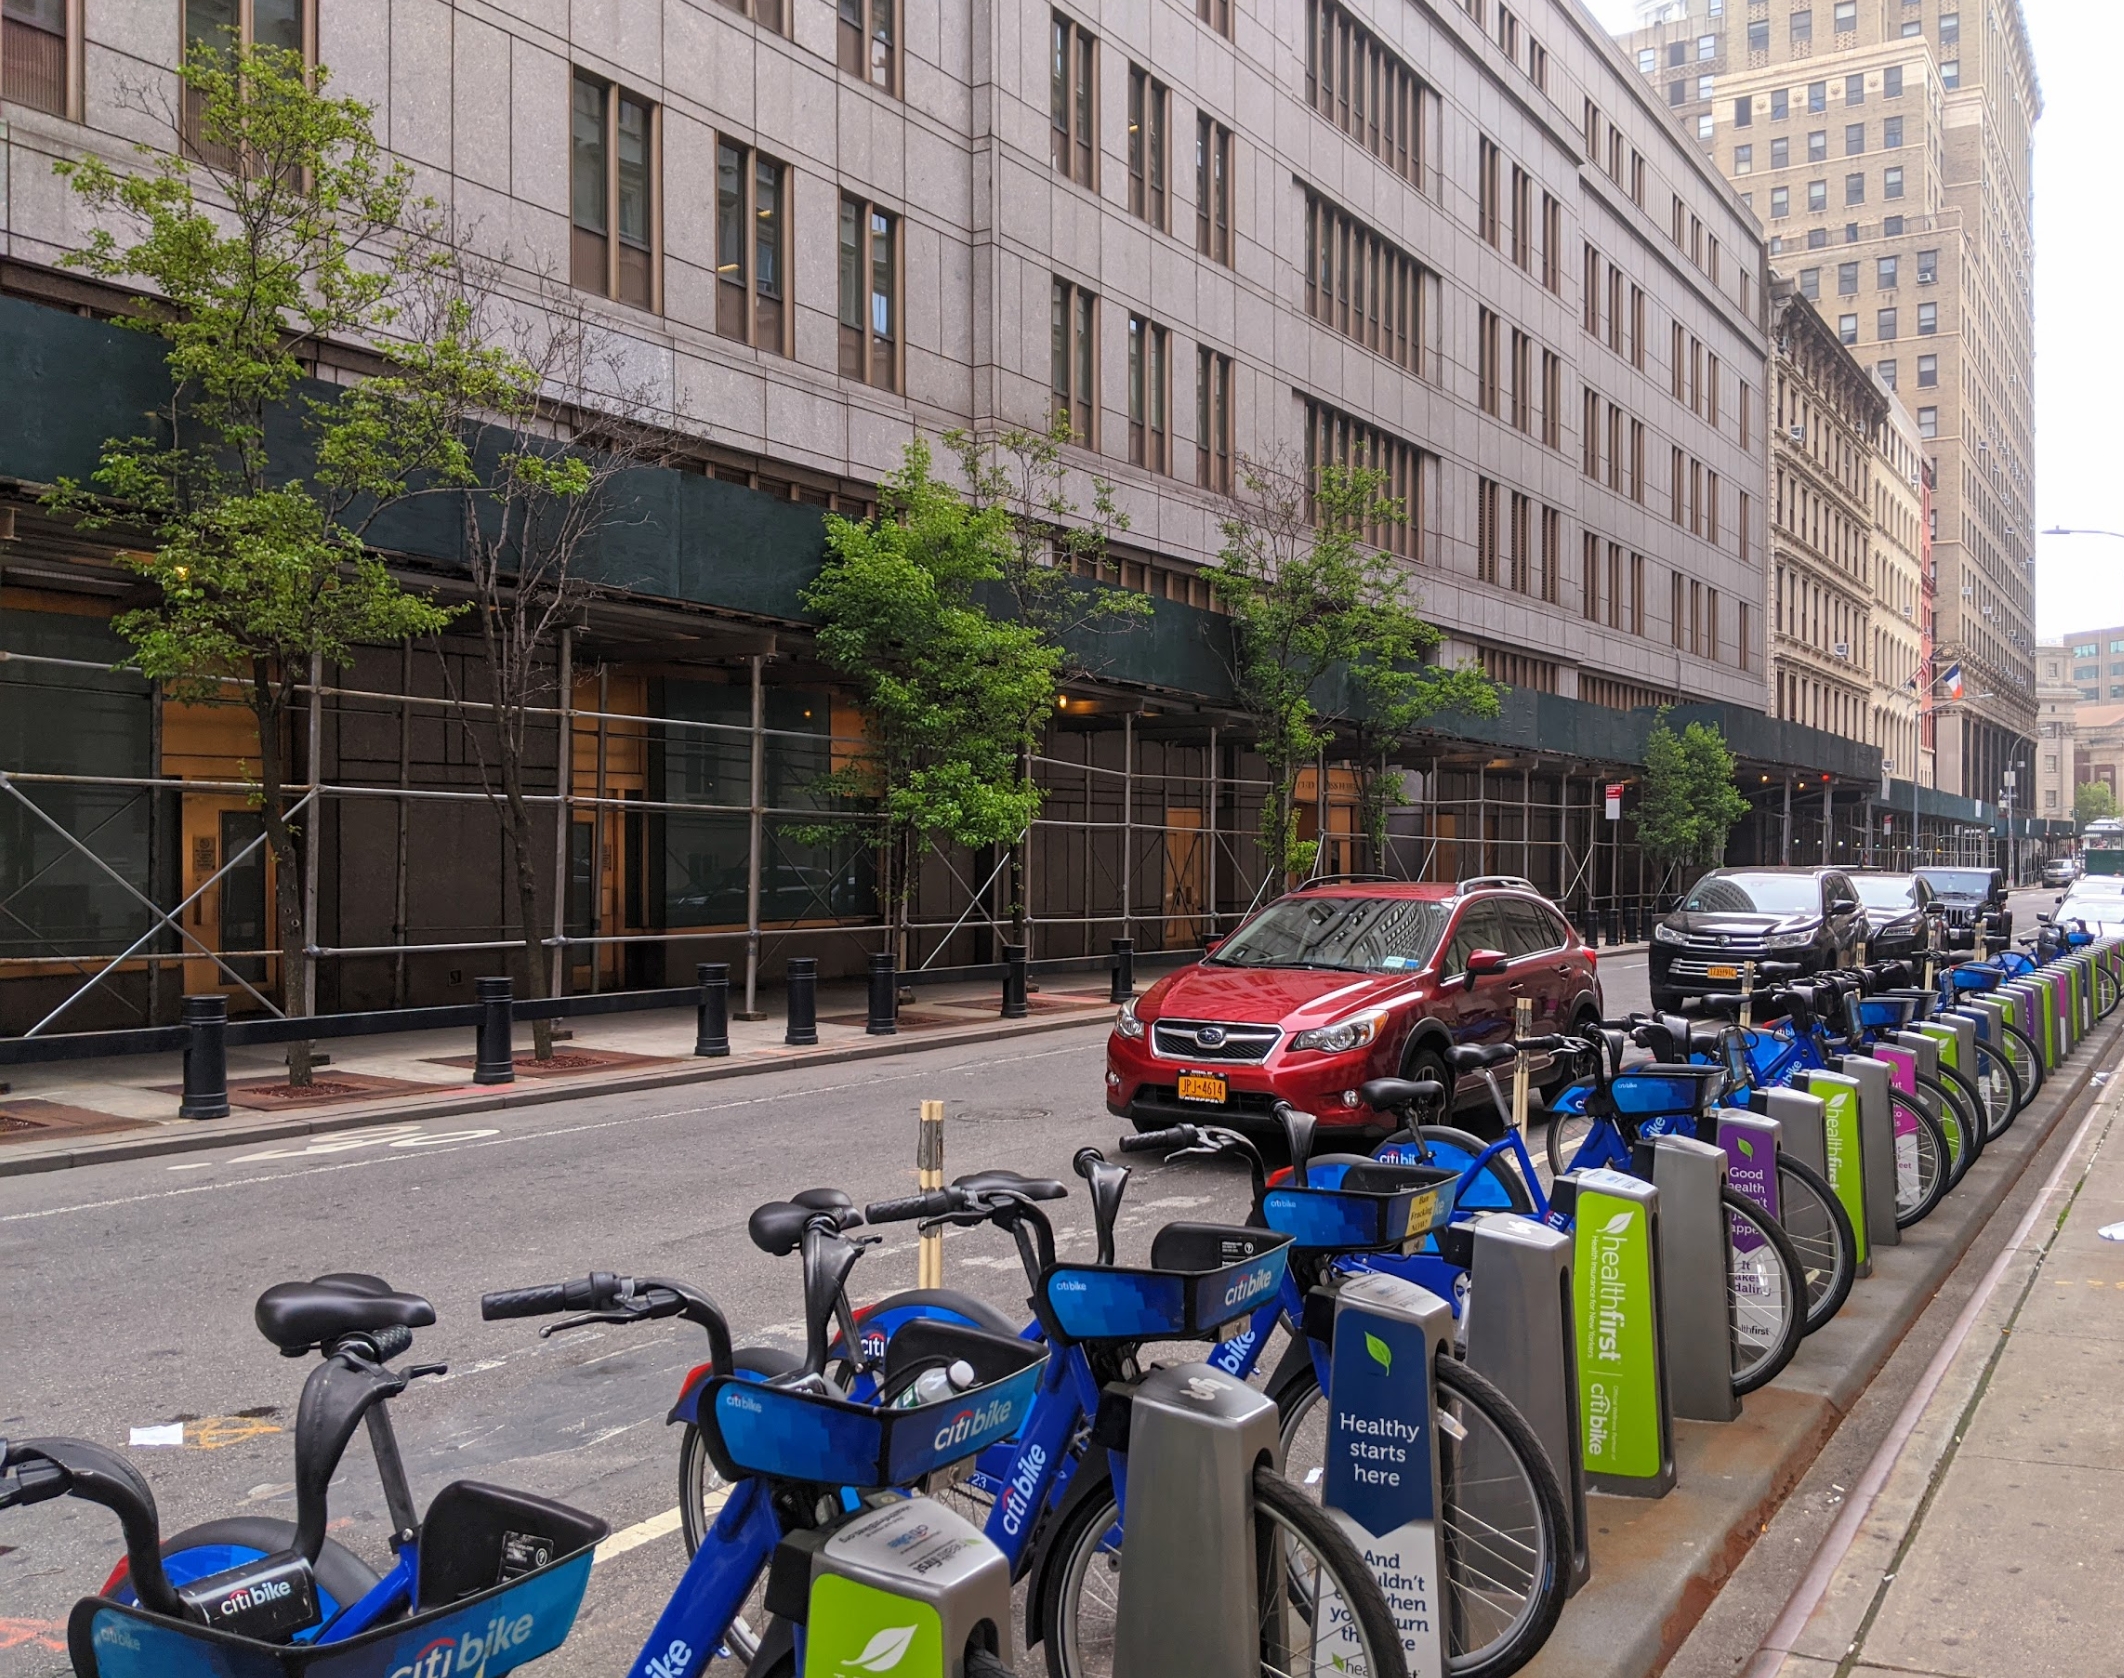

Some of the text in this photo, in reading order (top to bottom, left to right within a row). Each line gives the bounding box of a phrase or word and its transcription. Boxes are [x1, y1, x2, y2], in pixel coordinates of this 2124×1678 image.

[1729, 1167, 1764, 1180] Good
[1591, 1235, 1599, 1261] Health
[1741, 1260, 1751, 1270] It
[1590, 1261, 1598, 1298] Insurance
[1599, 1236, 1628, 1361] healthfirst
[1588, 1311, 1596, 1330] New
[1587, 1330, 1596, 1359] Yorkers
[1340, 1412, 1420, 1443] Healthy
[1350, 1441, 1406, 1462] starts
[1353, 1463, 1400, 1486] here
[1364, 1550, 1400, 1569] And
[1329, 1606, 1352, 1623] yo
[1341, 1626, 1362, 1643] th
